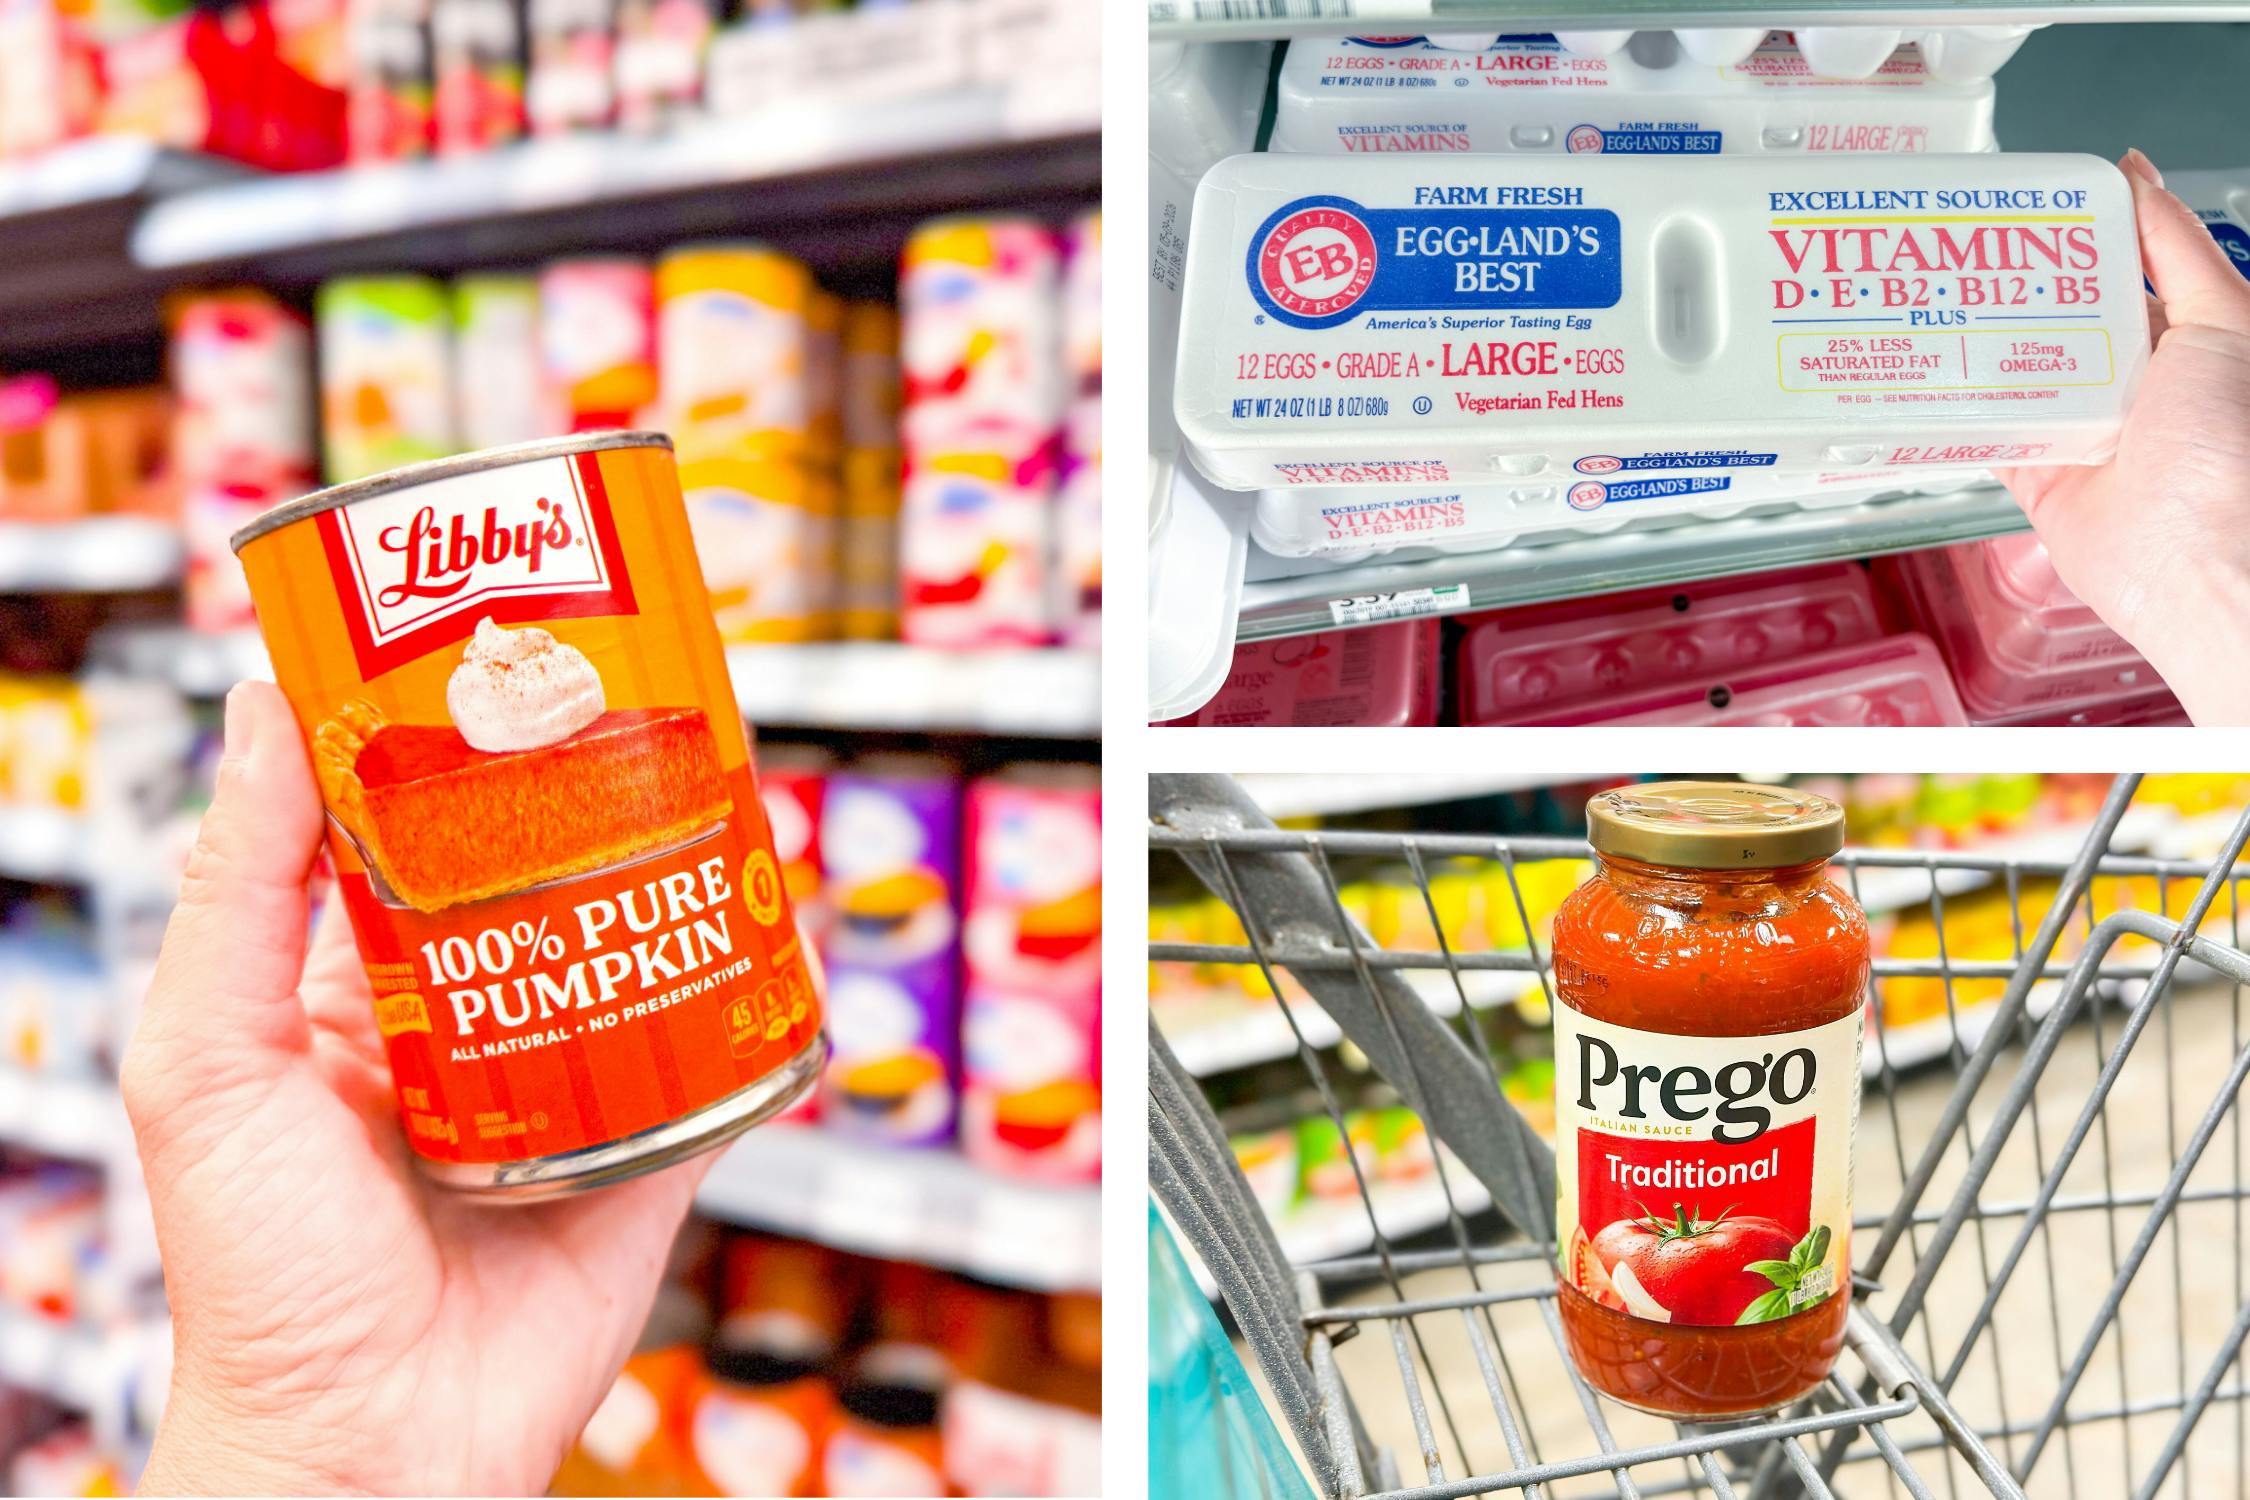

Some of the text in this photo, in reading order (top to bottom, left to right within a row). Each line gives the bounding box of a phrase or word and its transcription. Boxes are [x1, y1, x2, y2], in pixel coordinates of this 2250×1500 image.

[1326, 55, 1607, 71] 12 EGGS GRADE A LARGE EGGS
[1485, 76, 1608, 88] Vegetarian Fed Hens
[1338, 123, 1468, 135] EXCELLENT SOURCE OF
[1619, 122, 1699, 131] FARM FRESH
[1339, 133, 1471, 152] VITAMINS
[1573, 134, 1599, 151] EB
[1684, 135, 1718, 151] BEST
[1807, 125, 1893, 151] 12 LARGE
[1414, 186, 1584, 206] FARM FRESH
[1768, 189, 2087, 211] EXCELLENT SOURCE OF
[1768, 226, 2099, 274] VITAMINS
[1284, 242, 1354, 284] EB
[1272, 256, 1372, 313] APPROVED
[1454, 261, 1541, 293] BEST
[1366, 315, 1592, 333] America's Superior Tasting Egg
[1910, 309, 1967, 326] PLUS
[1828, 338, 1913, 352] 25% LESS
[2010, 342, 2064, 358] 125mg
[1237, 341, 1625, 379] 12 EGGS GRADE A LARGE EGGS
[1800, 354, 1942, 371] SATURATED FAT
[1999, 358, 2077, 373] OMEGA-3
[1818, 371, 1927, 382] THAN REGULAR EGGS
[1455, 389, 1624, 415] Vegetarian Fed Hens
[1838, 394, 1852, 403] PER
[1856, 394, 1871, 403] EGG
[1898, 393, 1936, 402] NUTRITION
[2027, 390, 2059, 400] CONTENT
[1232, 398, 1254, 418] NET
[1255, 398, 1272, 418] WT
[1274, 397, 1287, 418] 24
[1290, 397, 1304, 418] OZ
[1319, 396, 1332, 417] LB
[1338, 396, 1344, 417] 8
[1727, 455, 1772, 466] BEST
[1889, 444, 2005, 462] 12 LARGE
[1273, 462, 1356, 470] EXCELLENT
[1361, 460, 1421, 468] SOURCE
[1279, 464, 1448, 478] VITAMINS
[1583, 460, 1617, 471] EB
[1691, 476, 1726, 491] BEST
[1322, 494, 1462, 516] EXCELLENT SOURCE OF
[1323, 502, 1465, 529] VITAMINS
[379, 497, 573, 608] Libby's
[420, 915, 565, 986] 100%
[573, 855, 732, 950] PURE
[447, 910, 733, 1035] PUMPKIN
[451, 1046, 481, 1062] ALL
[483, 1027, 572, 1057] NATURAL
[589, 1012, 619, 1032] NO
[624, 956, 752, 1022] PRESERVATIVES
[732, 1001, 752, 1029] 45
[1576, 1033, 1817, 1145] Prego
[1590, 1116, 1693, 1135] ITALIAN SAUCE
[1606, 1148, 1779, 1189] Traditional
